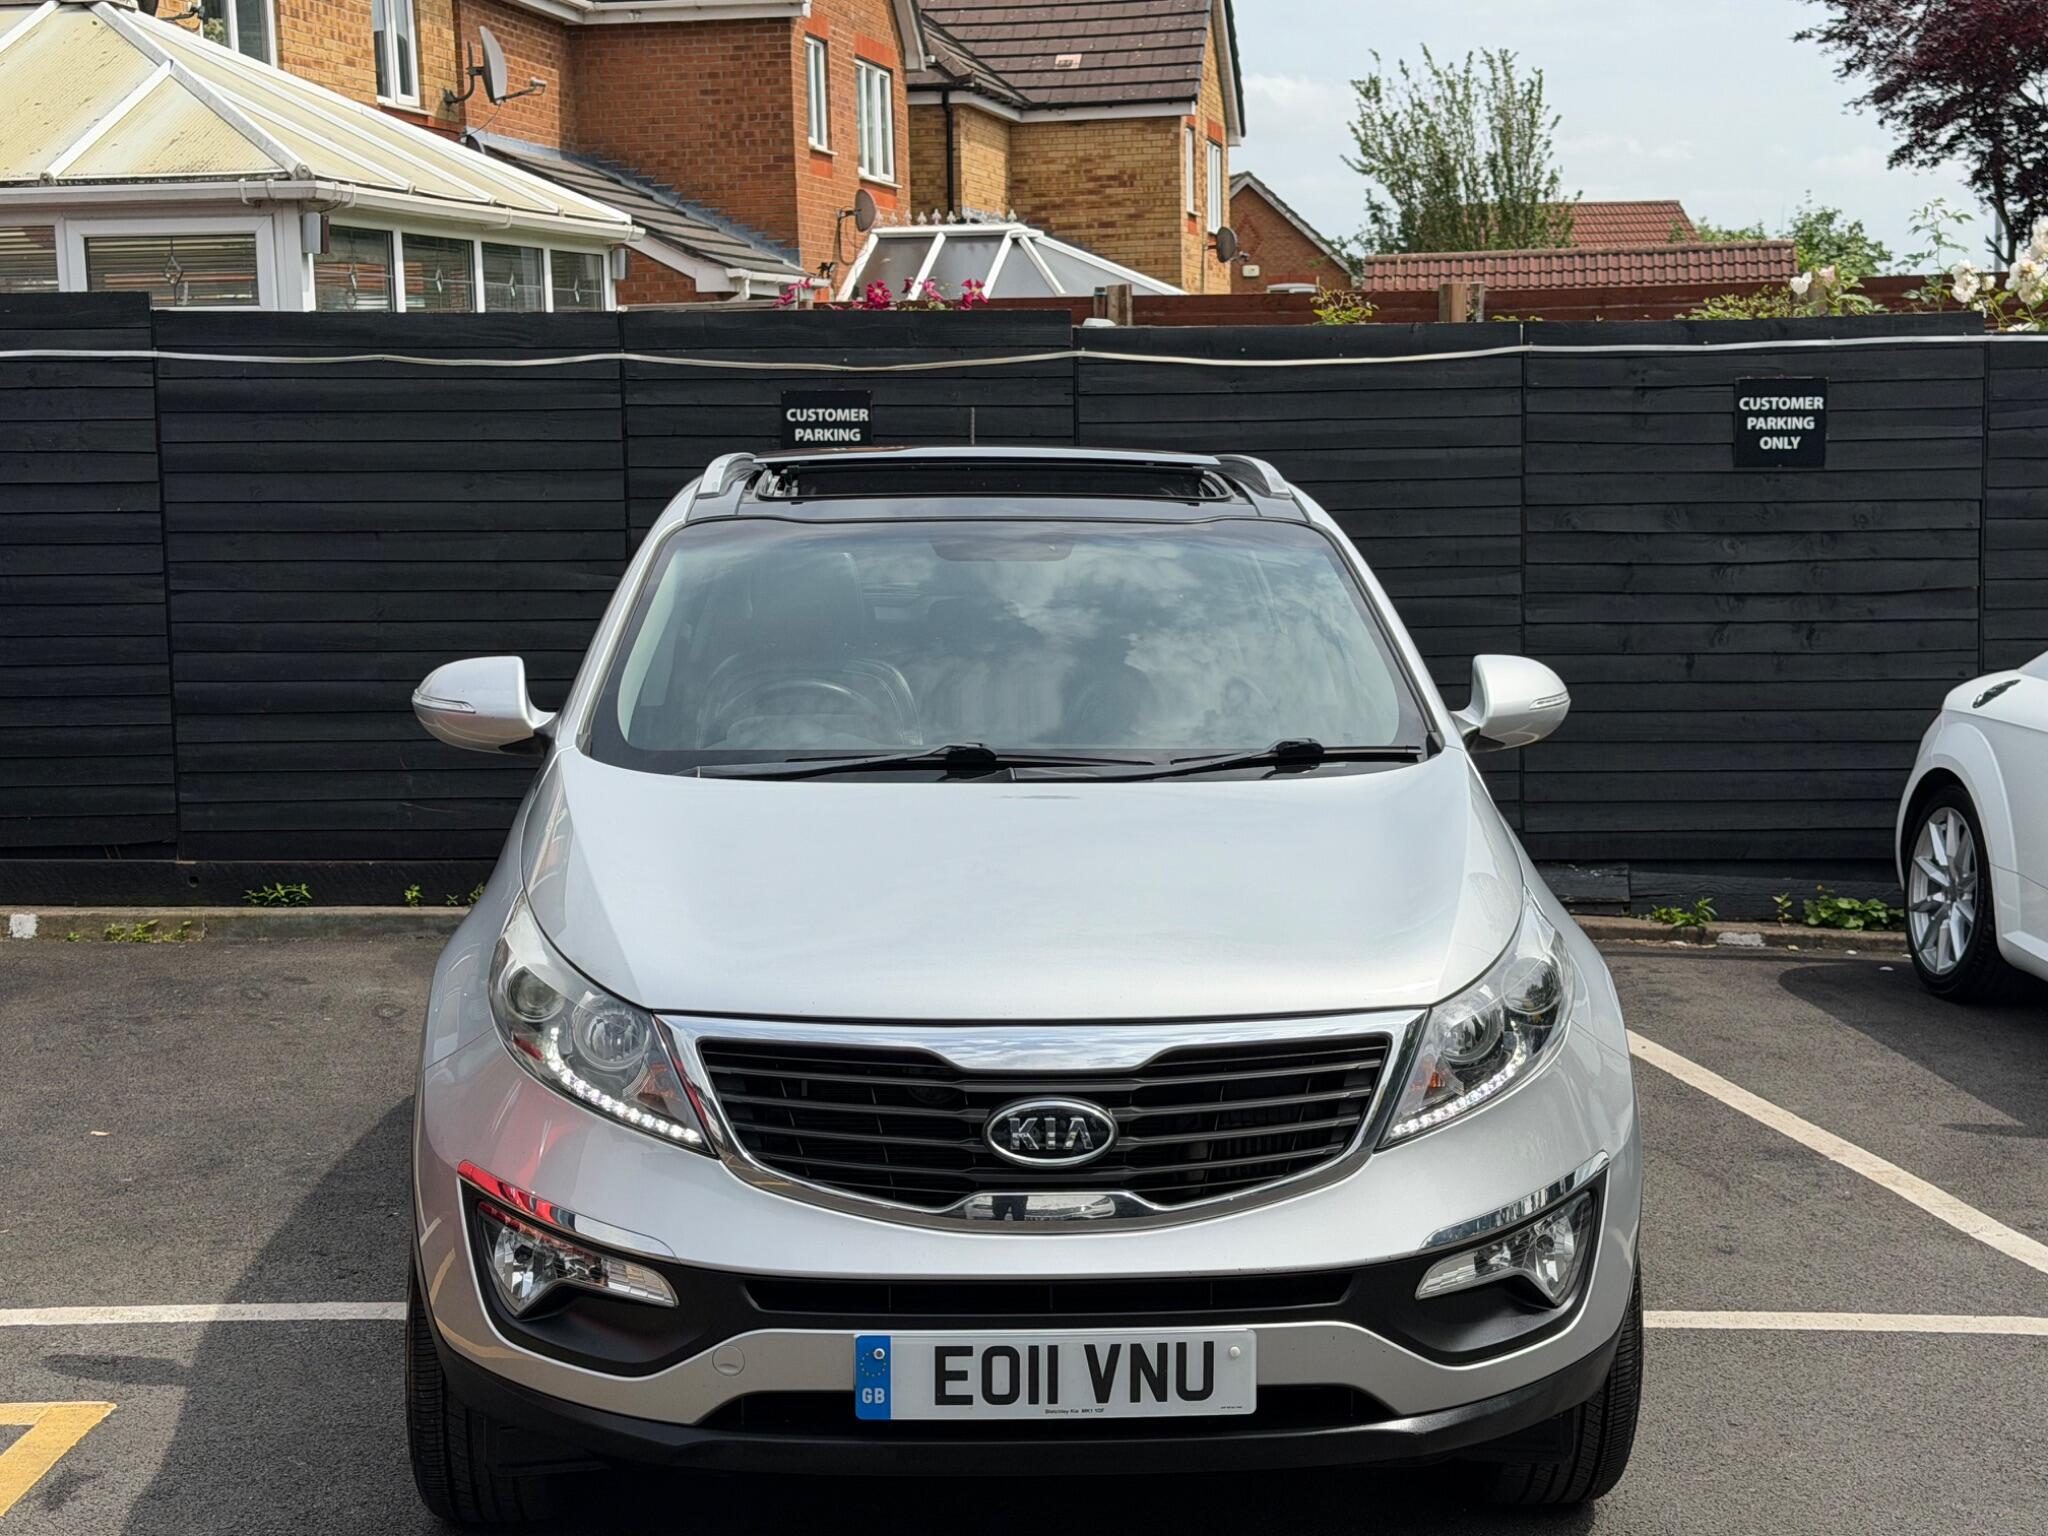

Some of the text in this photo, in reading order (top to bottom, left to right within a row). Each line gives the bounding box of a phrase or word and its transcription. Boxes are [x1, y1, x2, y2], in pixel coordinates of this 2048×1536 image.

[1739, 397, 1824, 411] CUSTOMER
[786, 408, 869, 422] CUSTOMER
[1746, 416, 1815, 430] PARKING
[794, 428, 861, 441] PARKING
[1759, 436, 1801, 450] ONLY
[1008, 1117, 1094, 1150] KIA
[1084, 1341, 1214, 1404] VNU
[862, 1388, 885, 1404] GB
